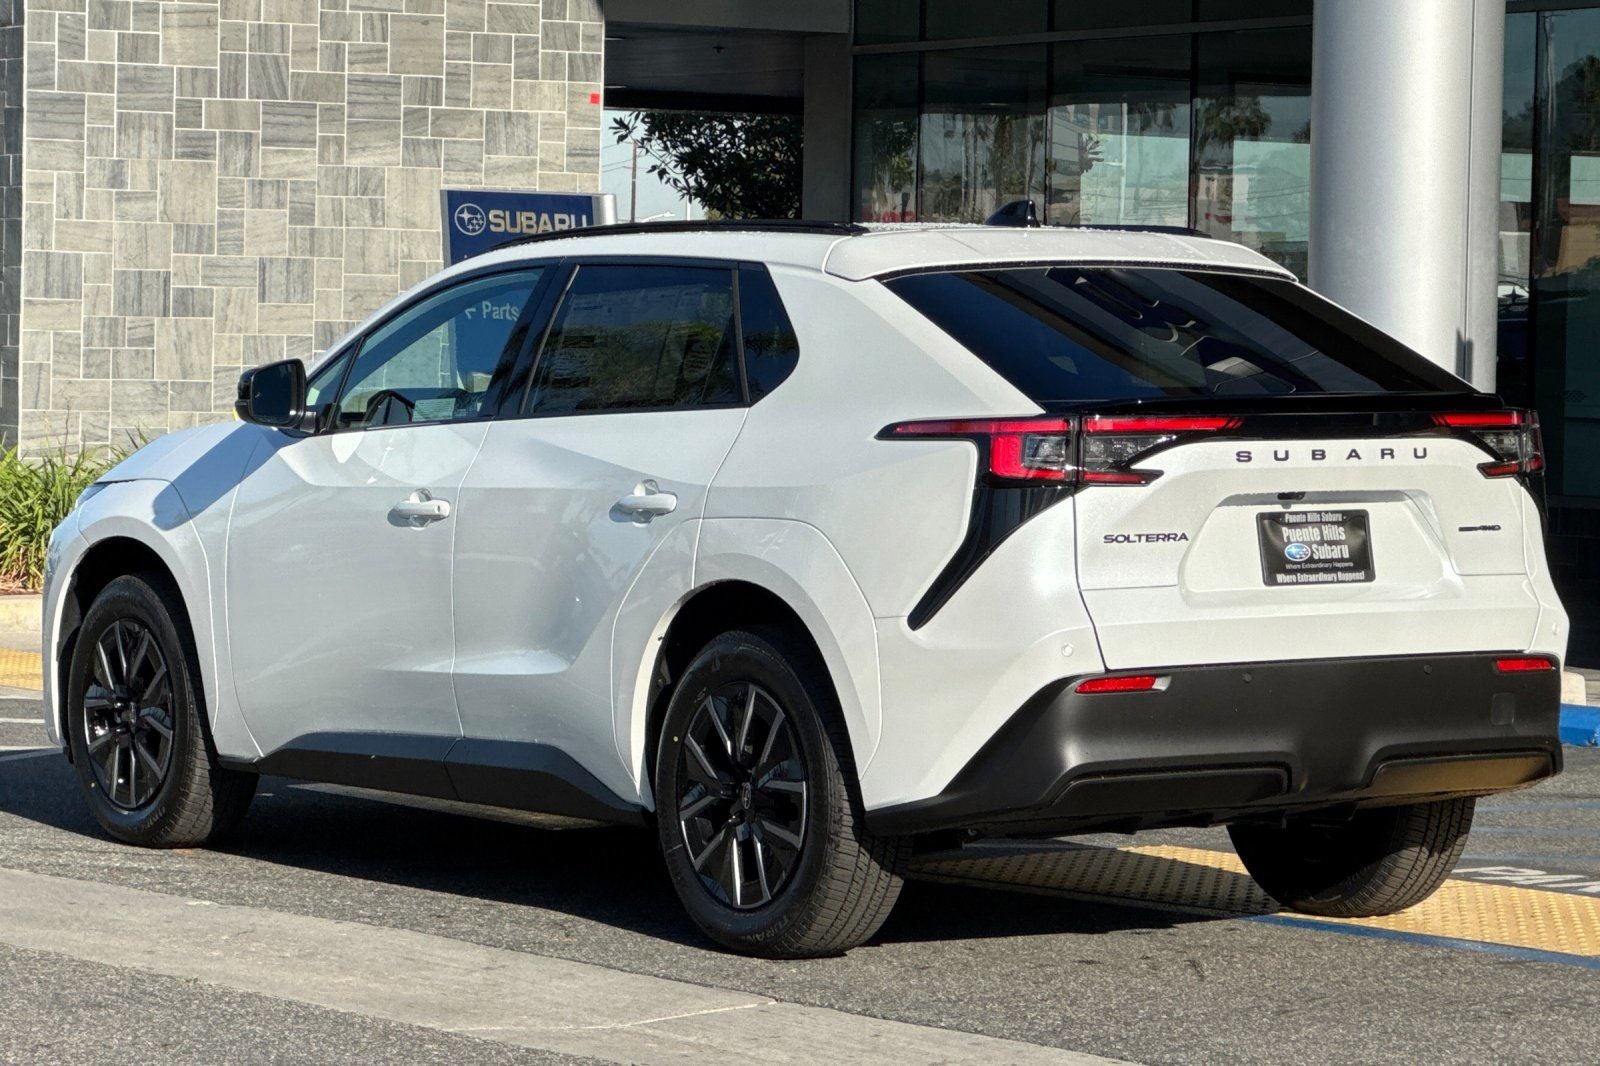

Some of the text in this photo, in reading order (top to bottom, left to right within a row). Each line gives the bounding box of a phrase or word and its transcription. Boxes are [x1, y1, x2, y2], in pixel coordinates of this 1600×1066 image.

[488, 209, 588, 234] SUBARU
[482, 300, 520, 321] Parts
[1235, 447, 1428, 463] SUBARU
[1285, 511, 1342, 524] Puente Hills Subaru
[1103, 532, 1189, 544] SOLTERRA
[1281, 523, 1346, 542] Puente Hills
[1311, 543, 1350, 560] Subaru
[1276, 573, 1297, 583] Where
[1297, 571, 1337, 583] Extraordinary
